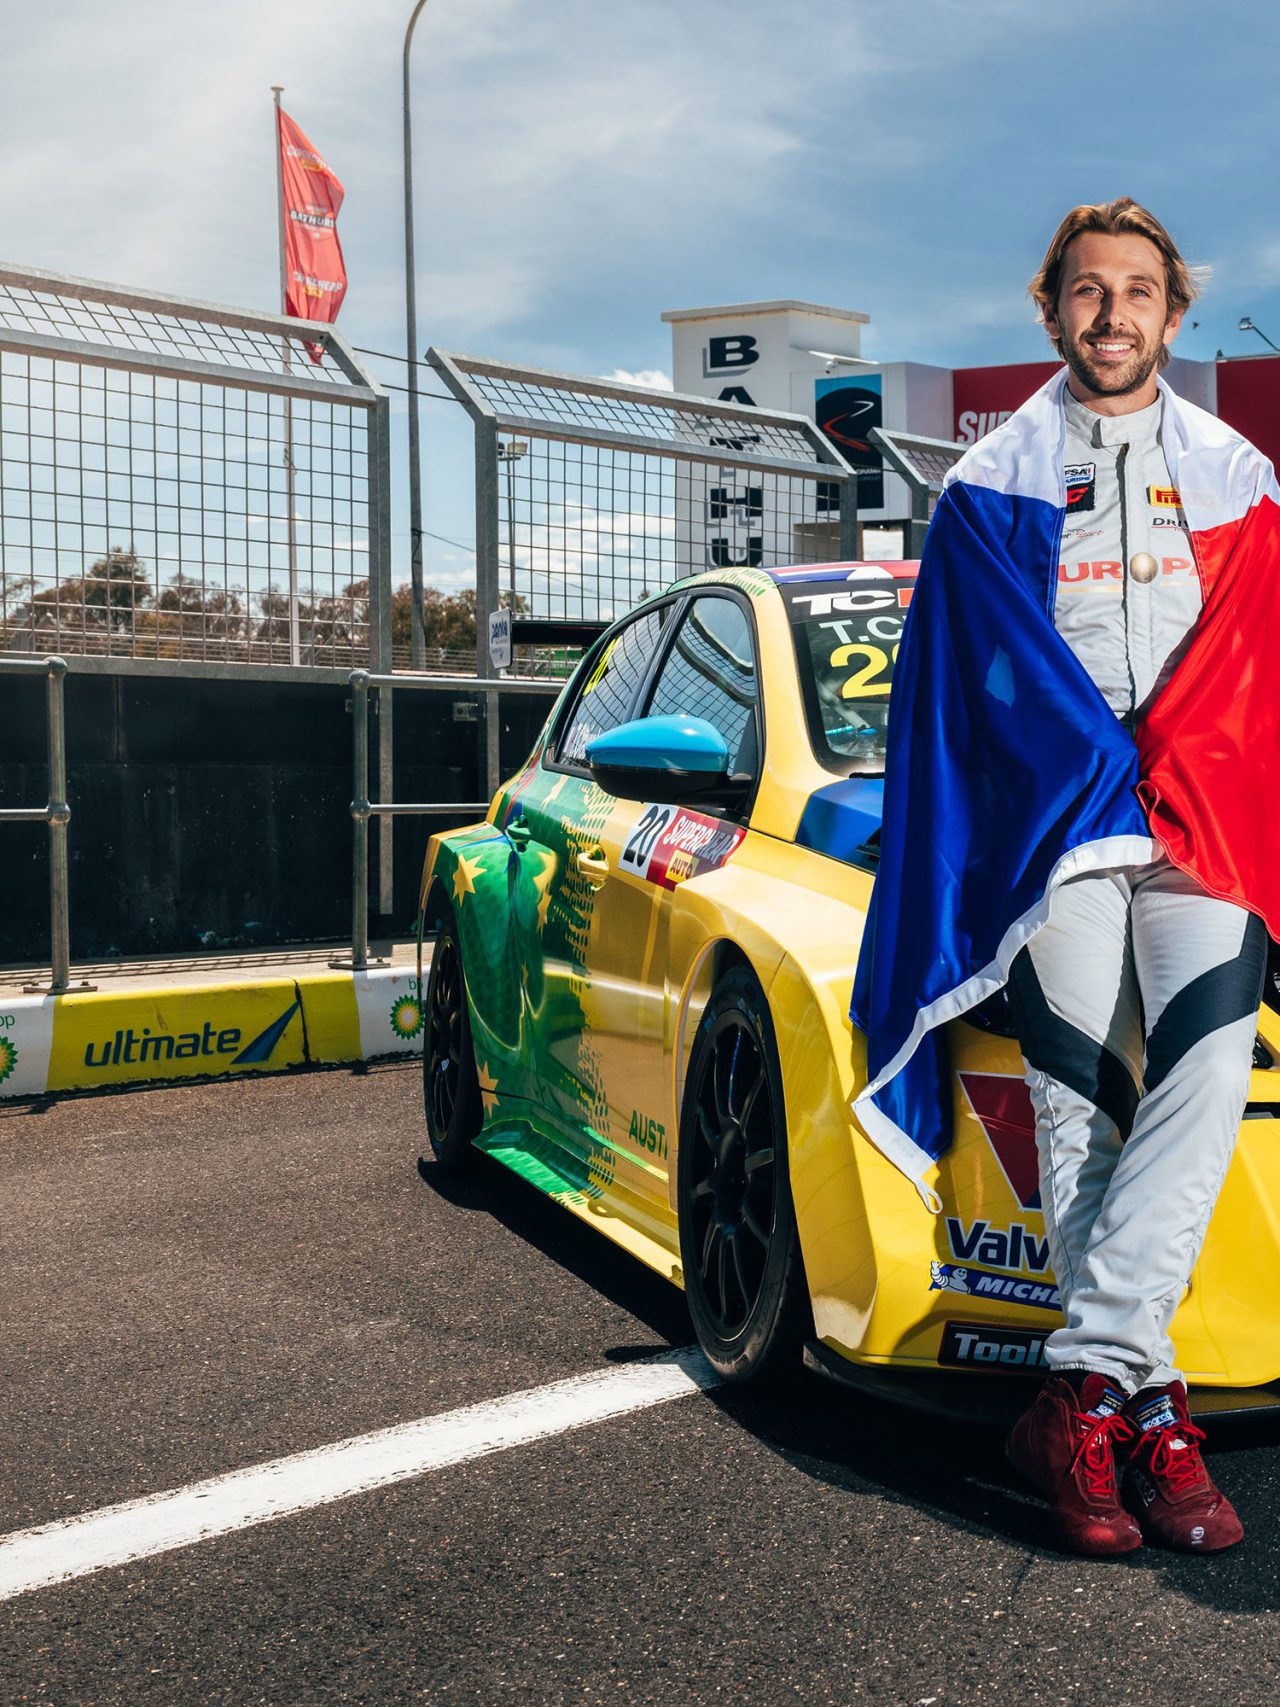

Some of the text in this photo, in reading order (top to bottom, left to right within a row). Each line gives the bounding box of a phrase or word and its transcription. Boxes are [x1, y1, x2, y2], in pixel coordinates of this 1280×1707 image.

[819, 615, 907, 644] T.C
[830, 643, 900, 699] 2
[622, 804, 671, 868] 20
[662, 815, 740, 865] SUPERCHEAP
[669, 857, 694, 880] AUTO
[408, 978, 424, 990] b
[84, 1021, 242, 1068] ultimate
